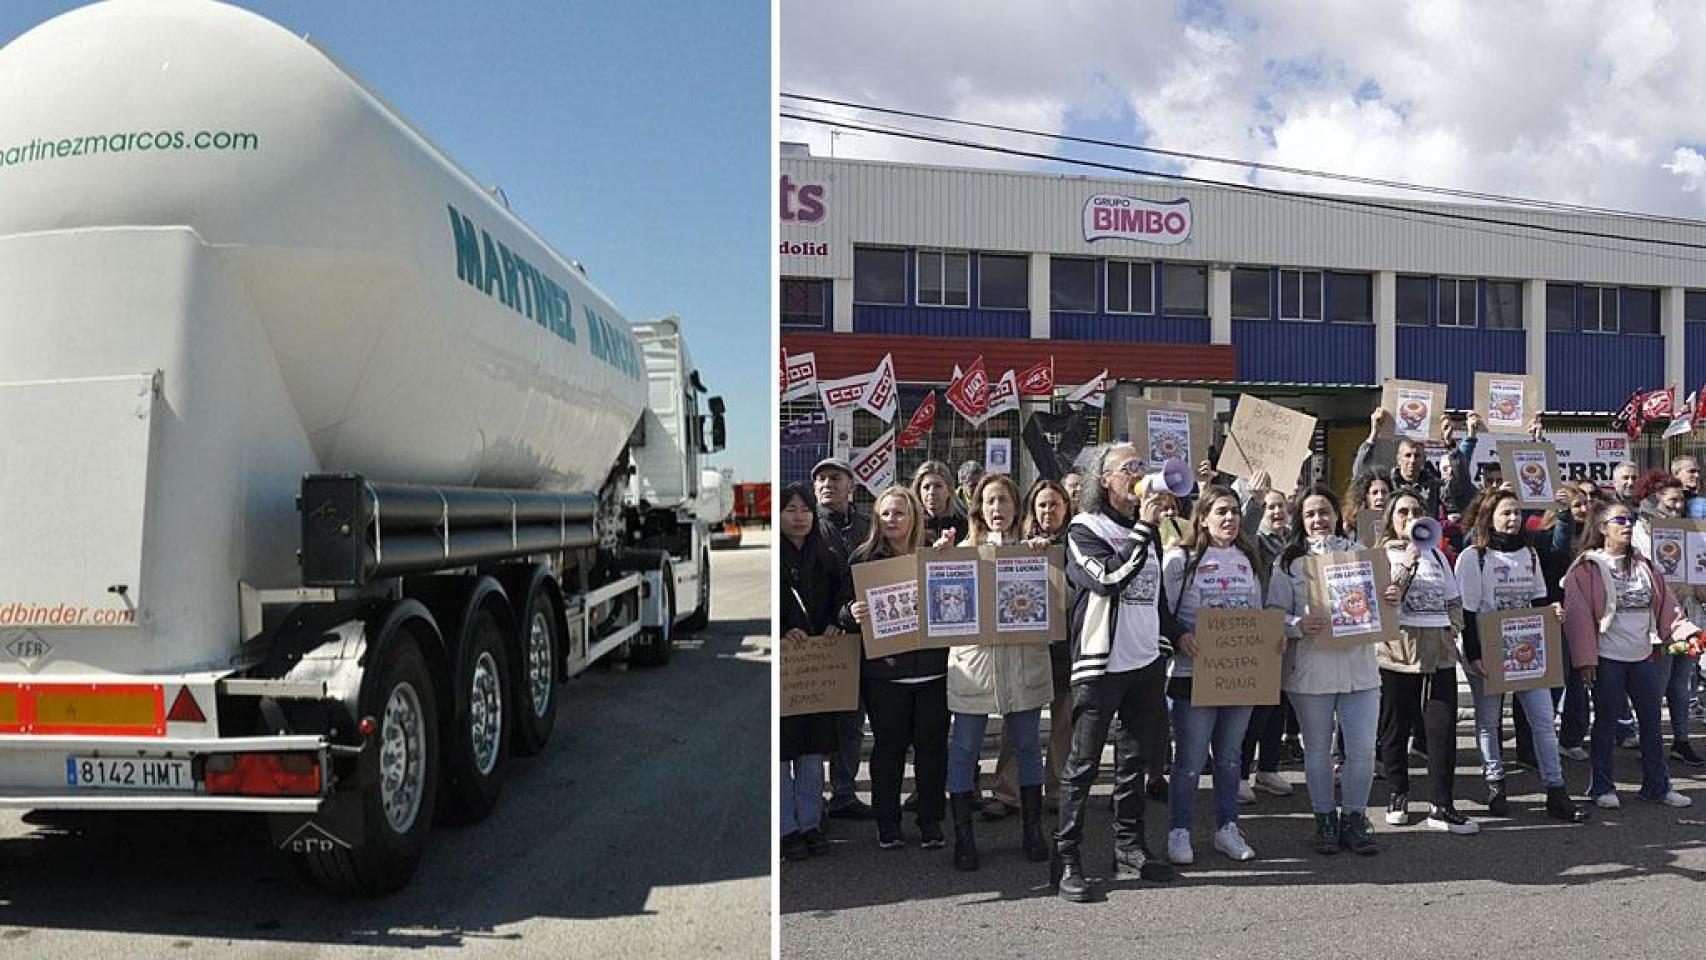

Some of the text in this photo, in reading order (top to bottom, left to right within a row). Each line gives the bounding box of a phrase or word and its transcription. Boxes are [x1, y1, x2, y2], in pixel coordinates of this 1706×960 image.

[0, 130, 259, 166] artinezmarcos.com
[1094, 198, 1130, 207] GRUPO
[1093, 207, 1186, 235] BIMBO
[448, 203, 576, 345] MARTINEZ
[81, 762, 136, 785] 8142
[143, 763, 184, 786] HMT
